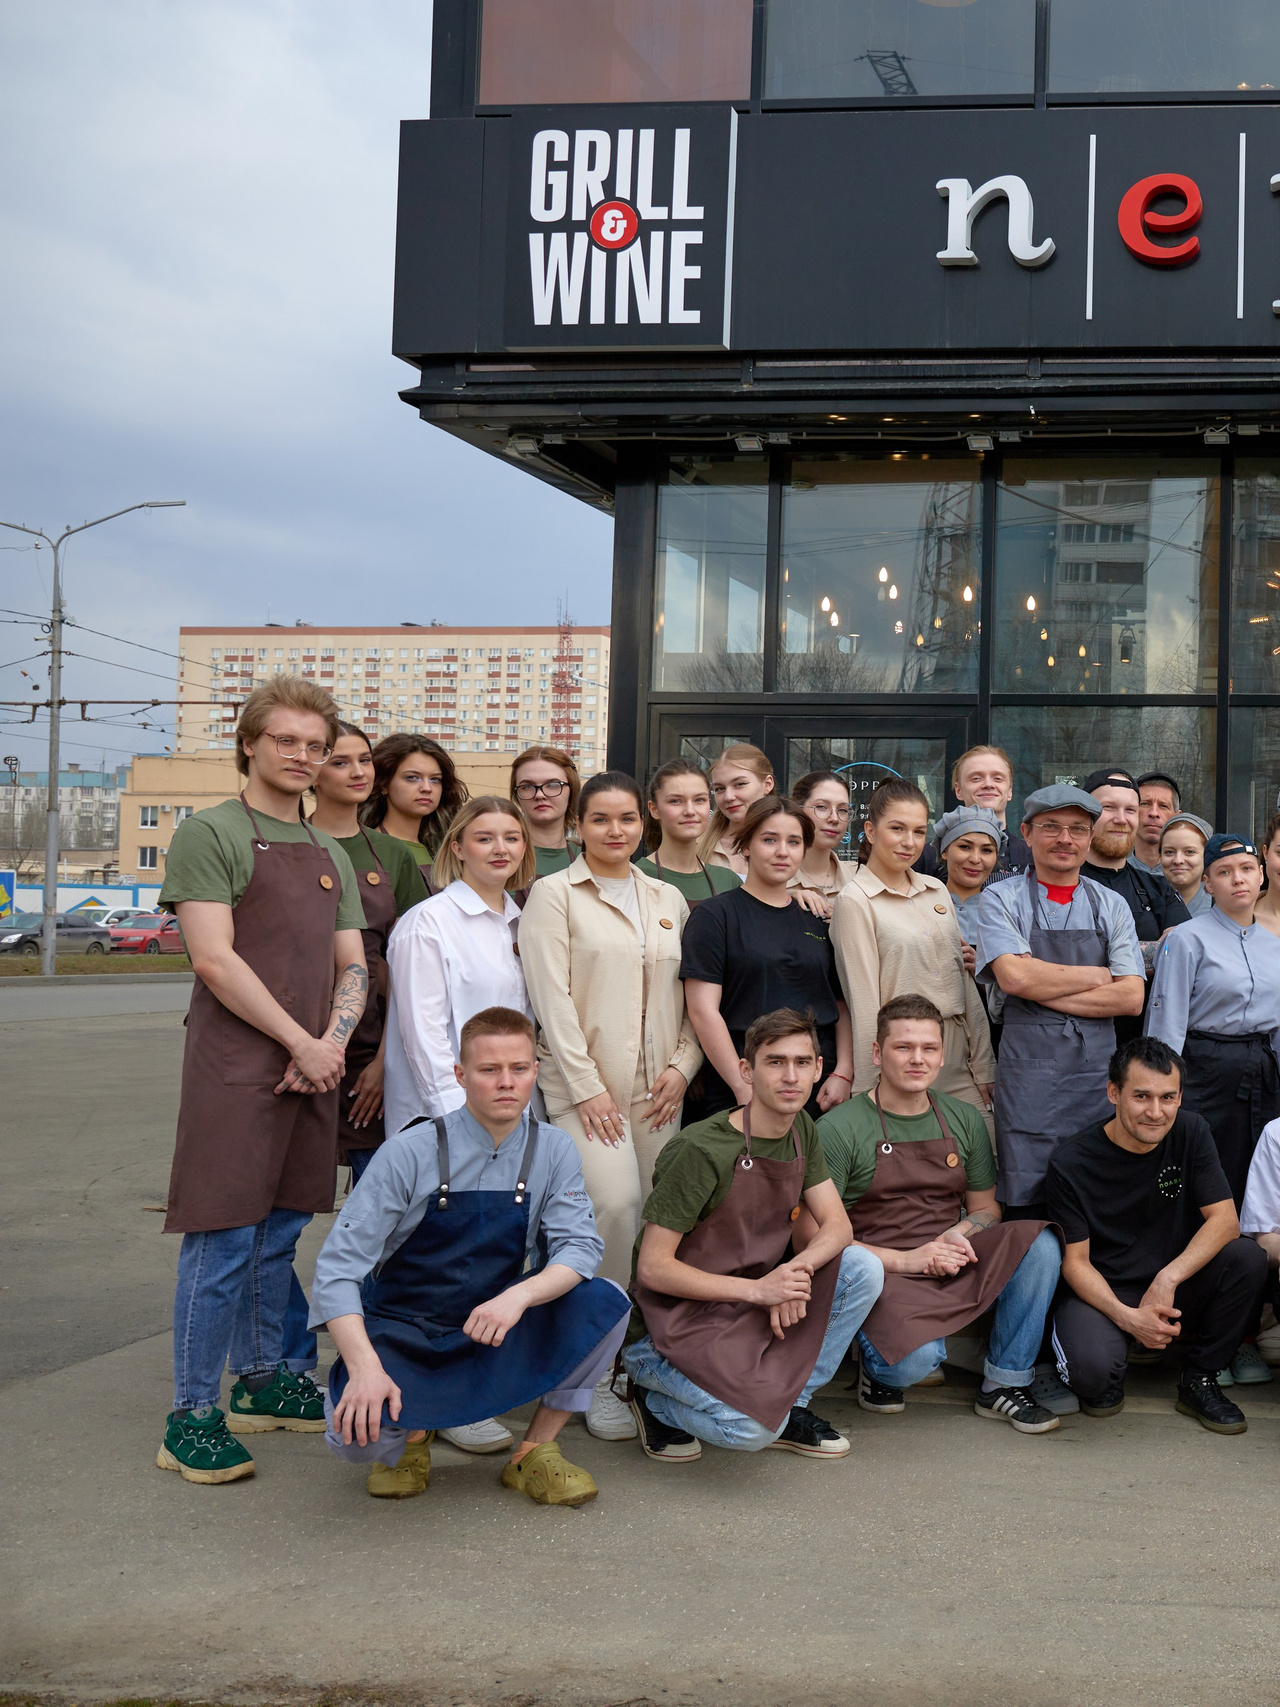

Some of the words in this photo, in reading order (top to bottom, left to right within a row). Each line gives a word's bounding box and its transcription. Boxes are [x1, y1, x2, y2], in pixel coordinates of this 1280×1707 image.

[530, 128, 704, 222] GRILL
[601, 209, 627, 241] &
[529, 231, 703, 325] WINE
